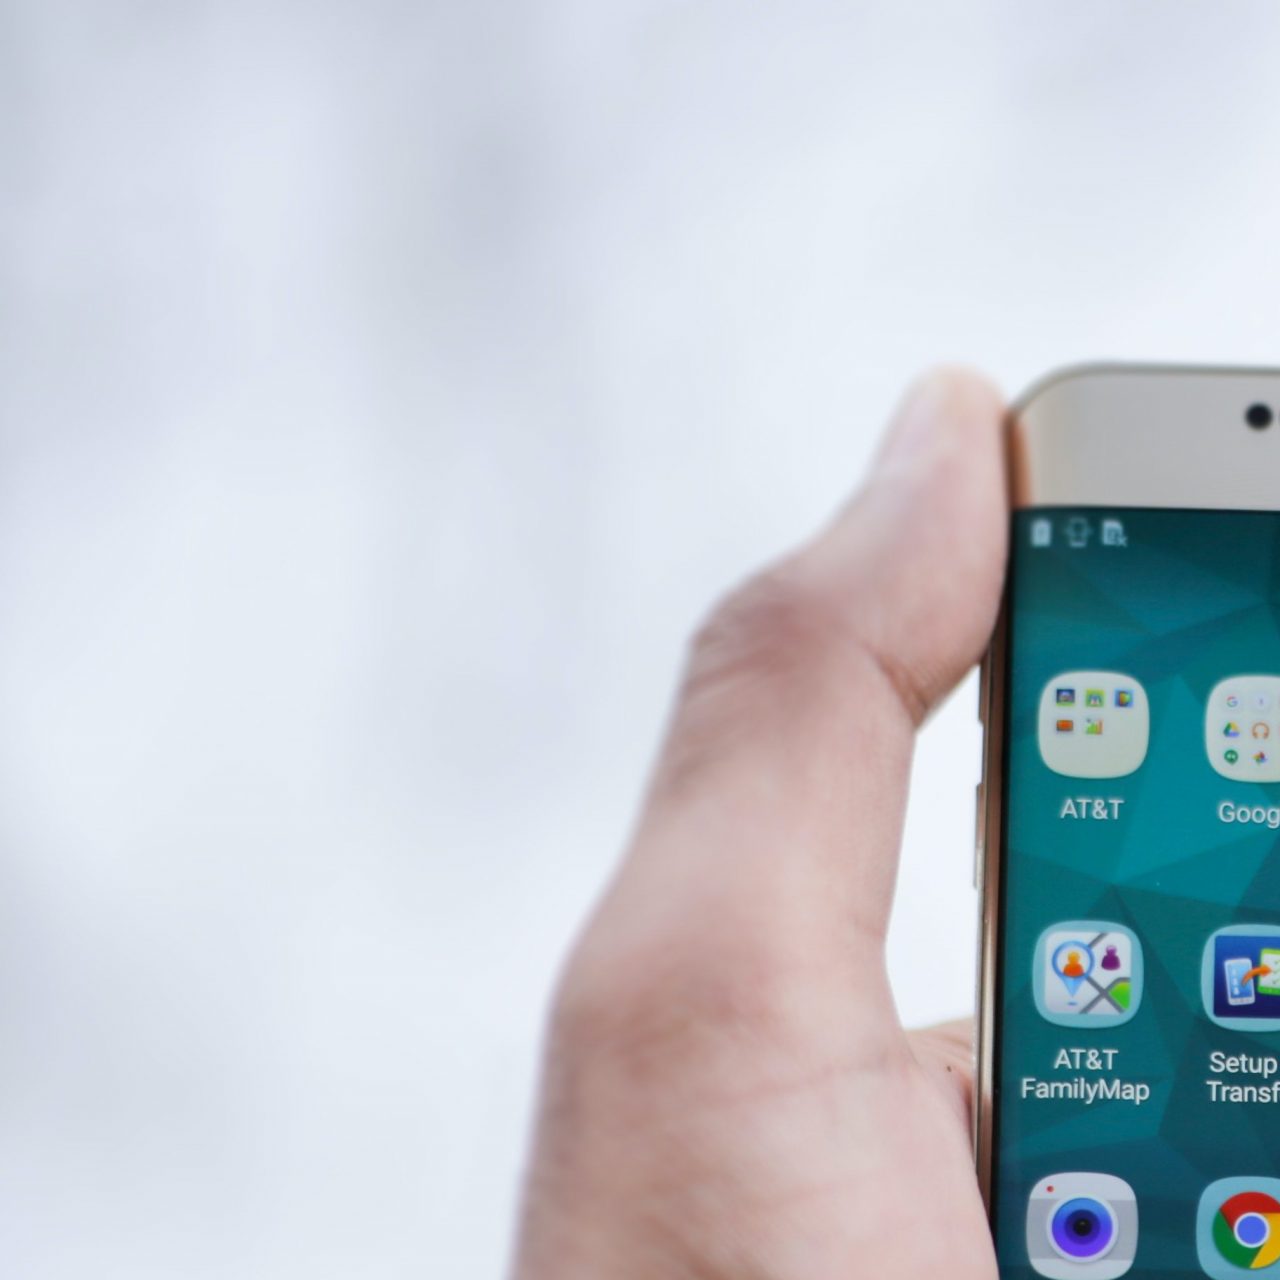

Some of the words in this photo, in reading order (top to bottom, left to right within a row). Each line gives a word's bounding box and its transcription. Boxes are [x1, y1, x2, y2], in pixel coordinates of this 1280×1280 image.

[1060, 799, 1124, 820] AT&T
[1054, 1049, 1118, 1070] AT&T
[1209, 1052, 1277, 1077] Setup
[1021, 1078, 1150, 1104] FamilyMap
